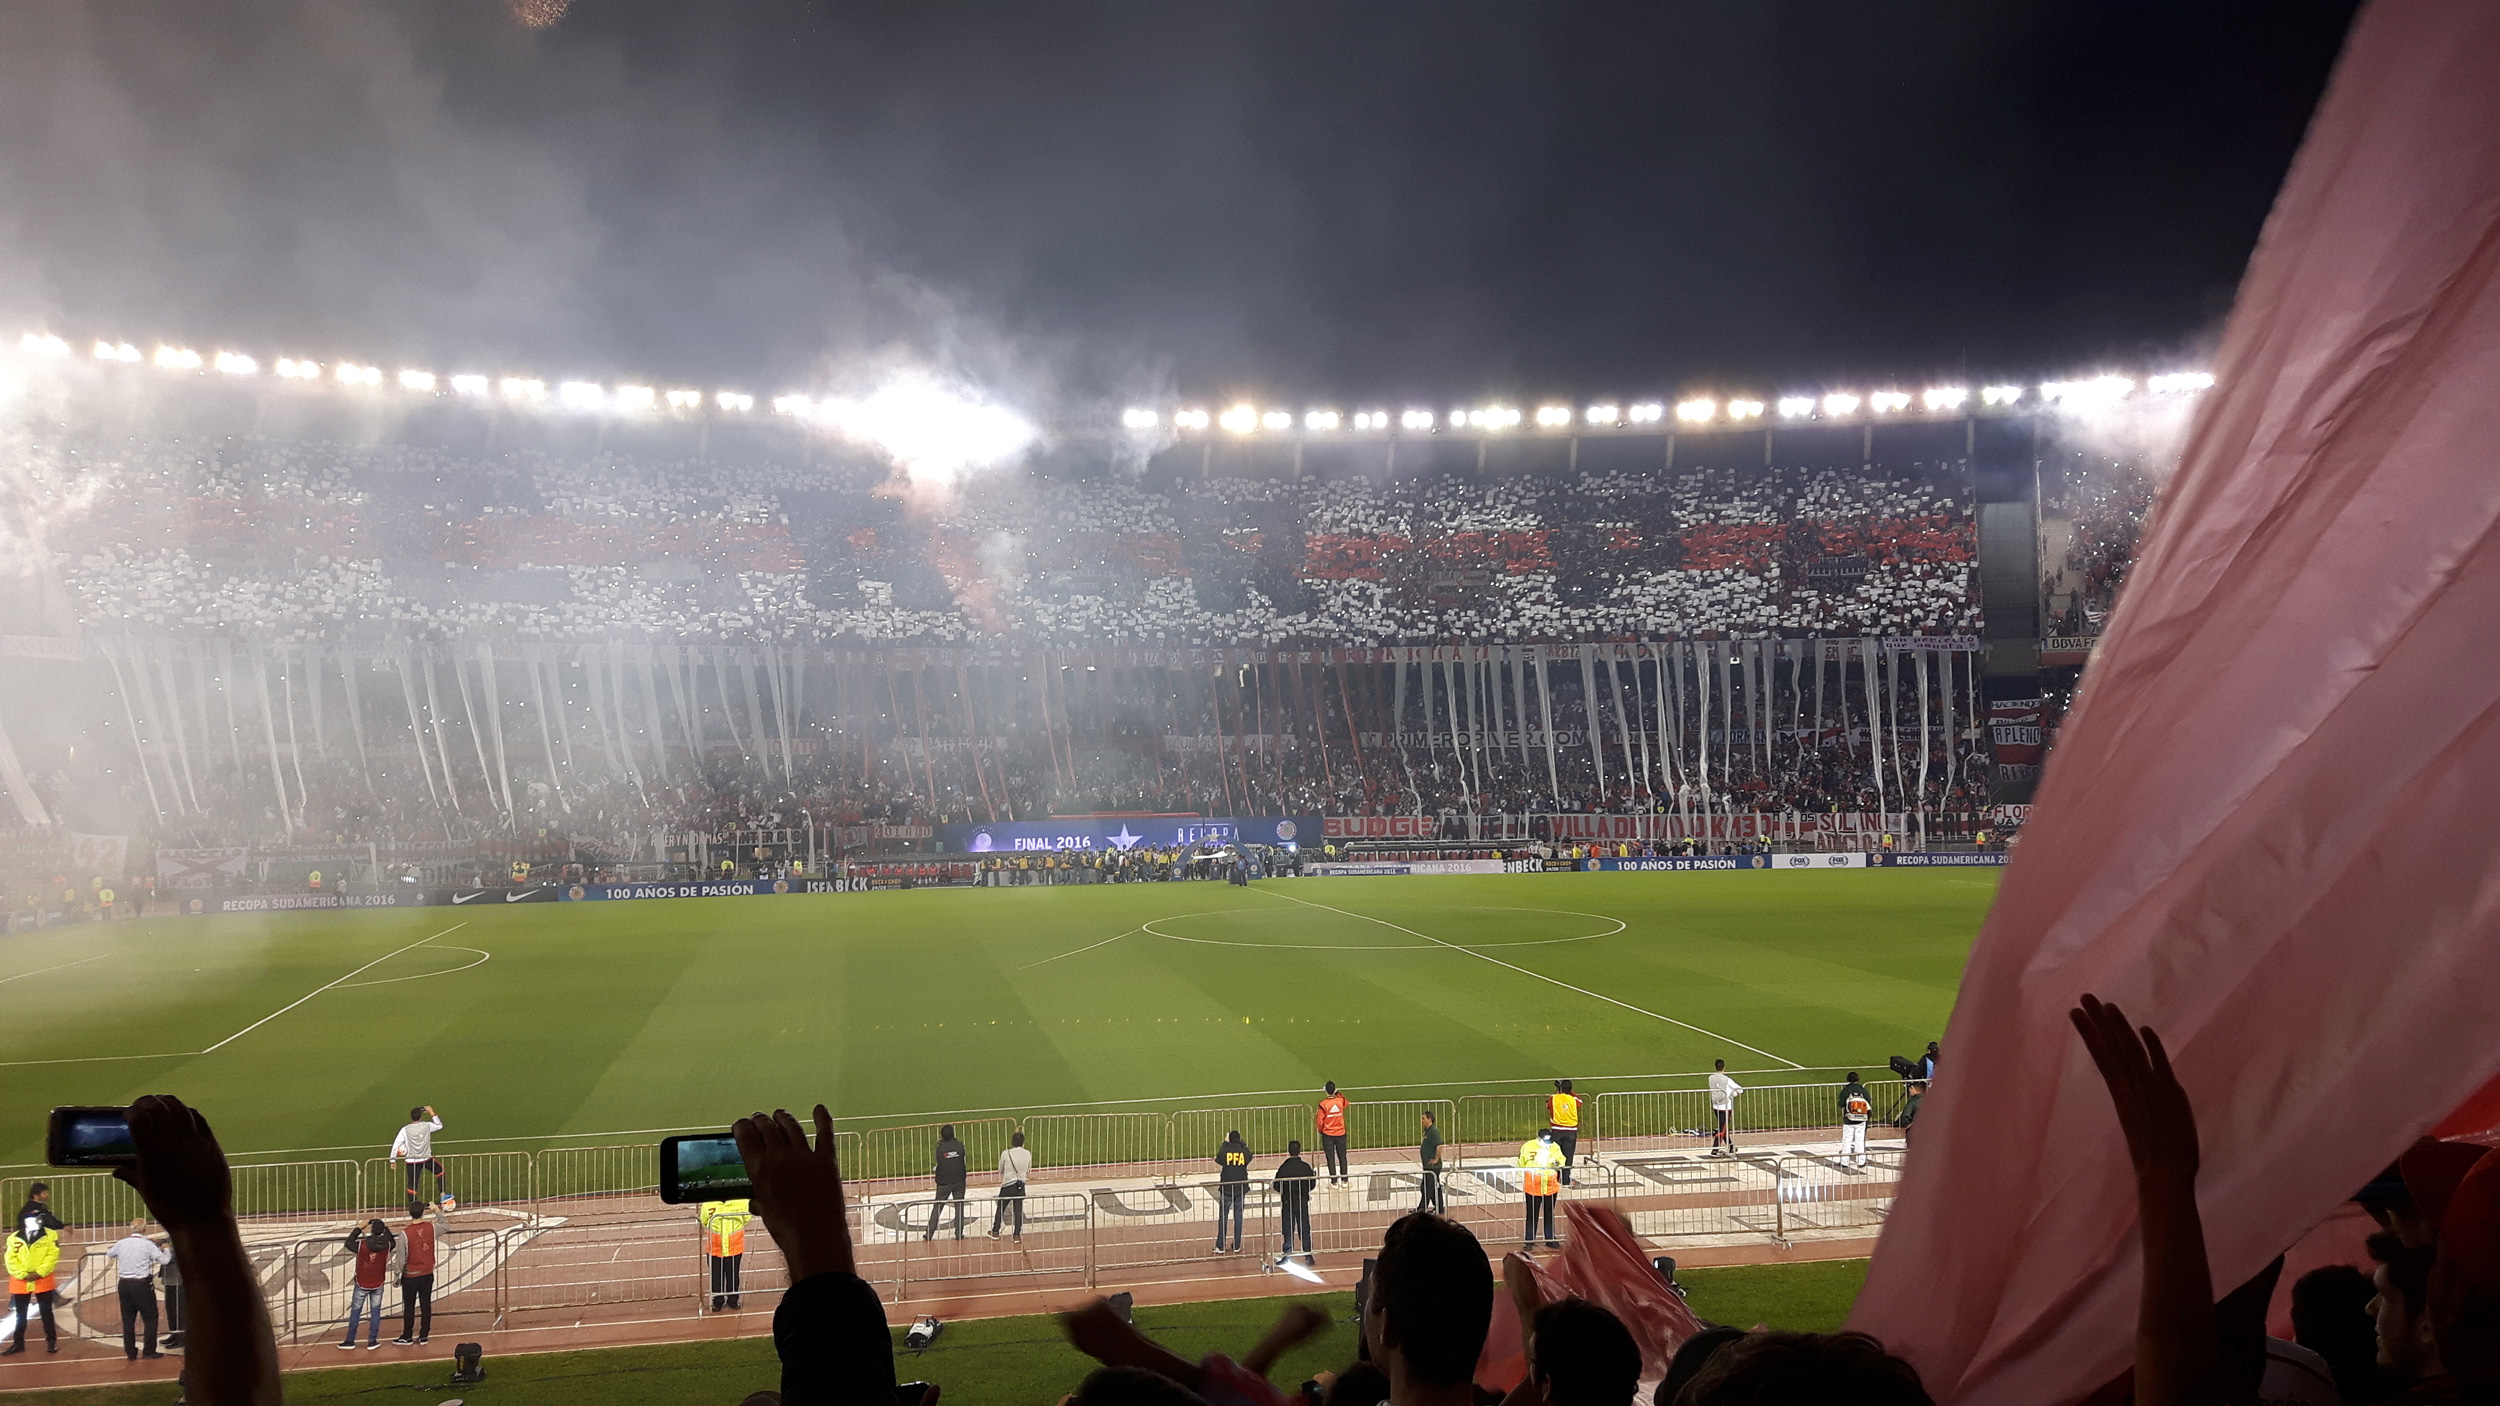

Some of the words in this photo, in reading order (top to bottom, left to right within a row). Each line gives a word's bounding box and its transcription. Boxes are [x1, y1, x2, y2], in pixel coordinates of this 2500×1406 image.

[2052, 639, 2082, 649] BBVA
[2005, 727, 2040, 744] PLENO
[1324, 816, 1434, 837] BUDGE
[1551, 815, 1610, 838] VILLA
[1014, 837, 1052, 850] FINAL
[1057, 836, 1091, 849] 2016
[1448, 862, 1472, 872] 2016
[1617, 861, 1637, 870] 100
[1640, 858, 1673, 870] AÑOS
[1677, 860, 1691, 870] DE
[1694, 857, 1736, 869] PASIÓN
[1896, 855, 1929, 865] RECOPA
[1931, 855, 1996, 865] SUDAMERICANA
[606, 888, 631, 899] 100
[635, 884, 676, 898] AÑOS
[680, 886, 698, 897] DE
[702, 882, 753, 897] PASIÓN
[223, 900, 269, 912] RECOPA
[272, 897, 362, 909] SUDAMERICANA
[365, 894, 396, 906] 2016
[1226, 1152, 1245, 1166] PFA
